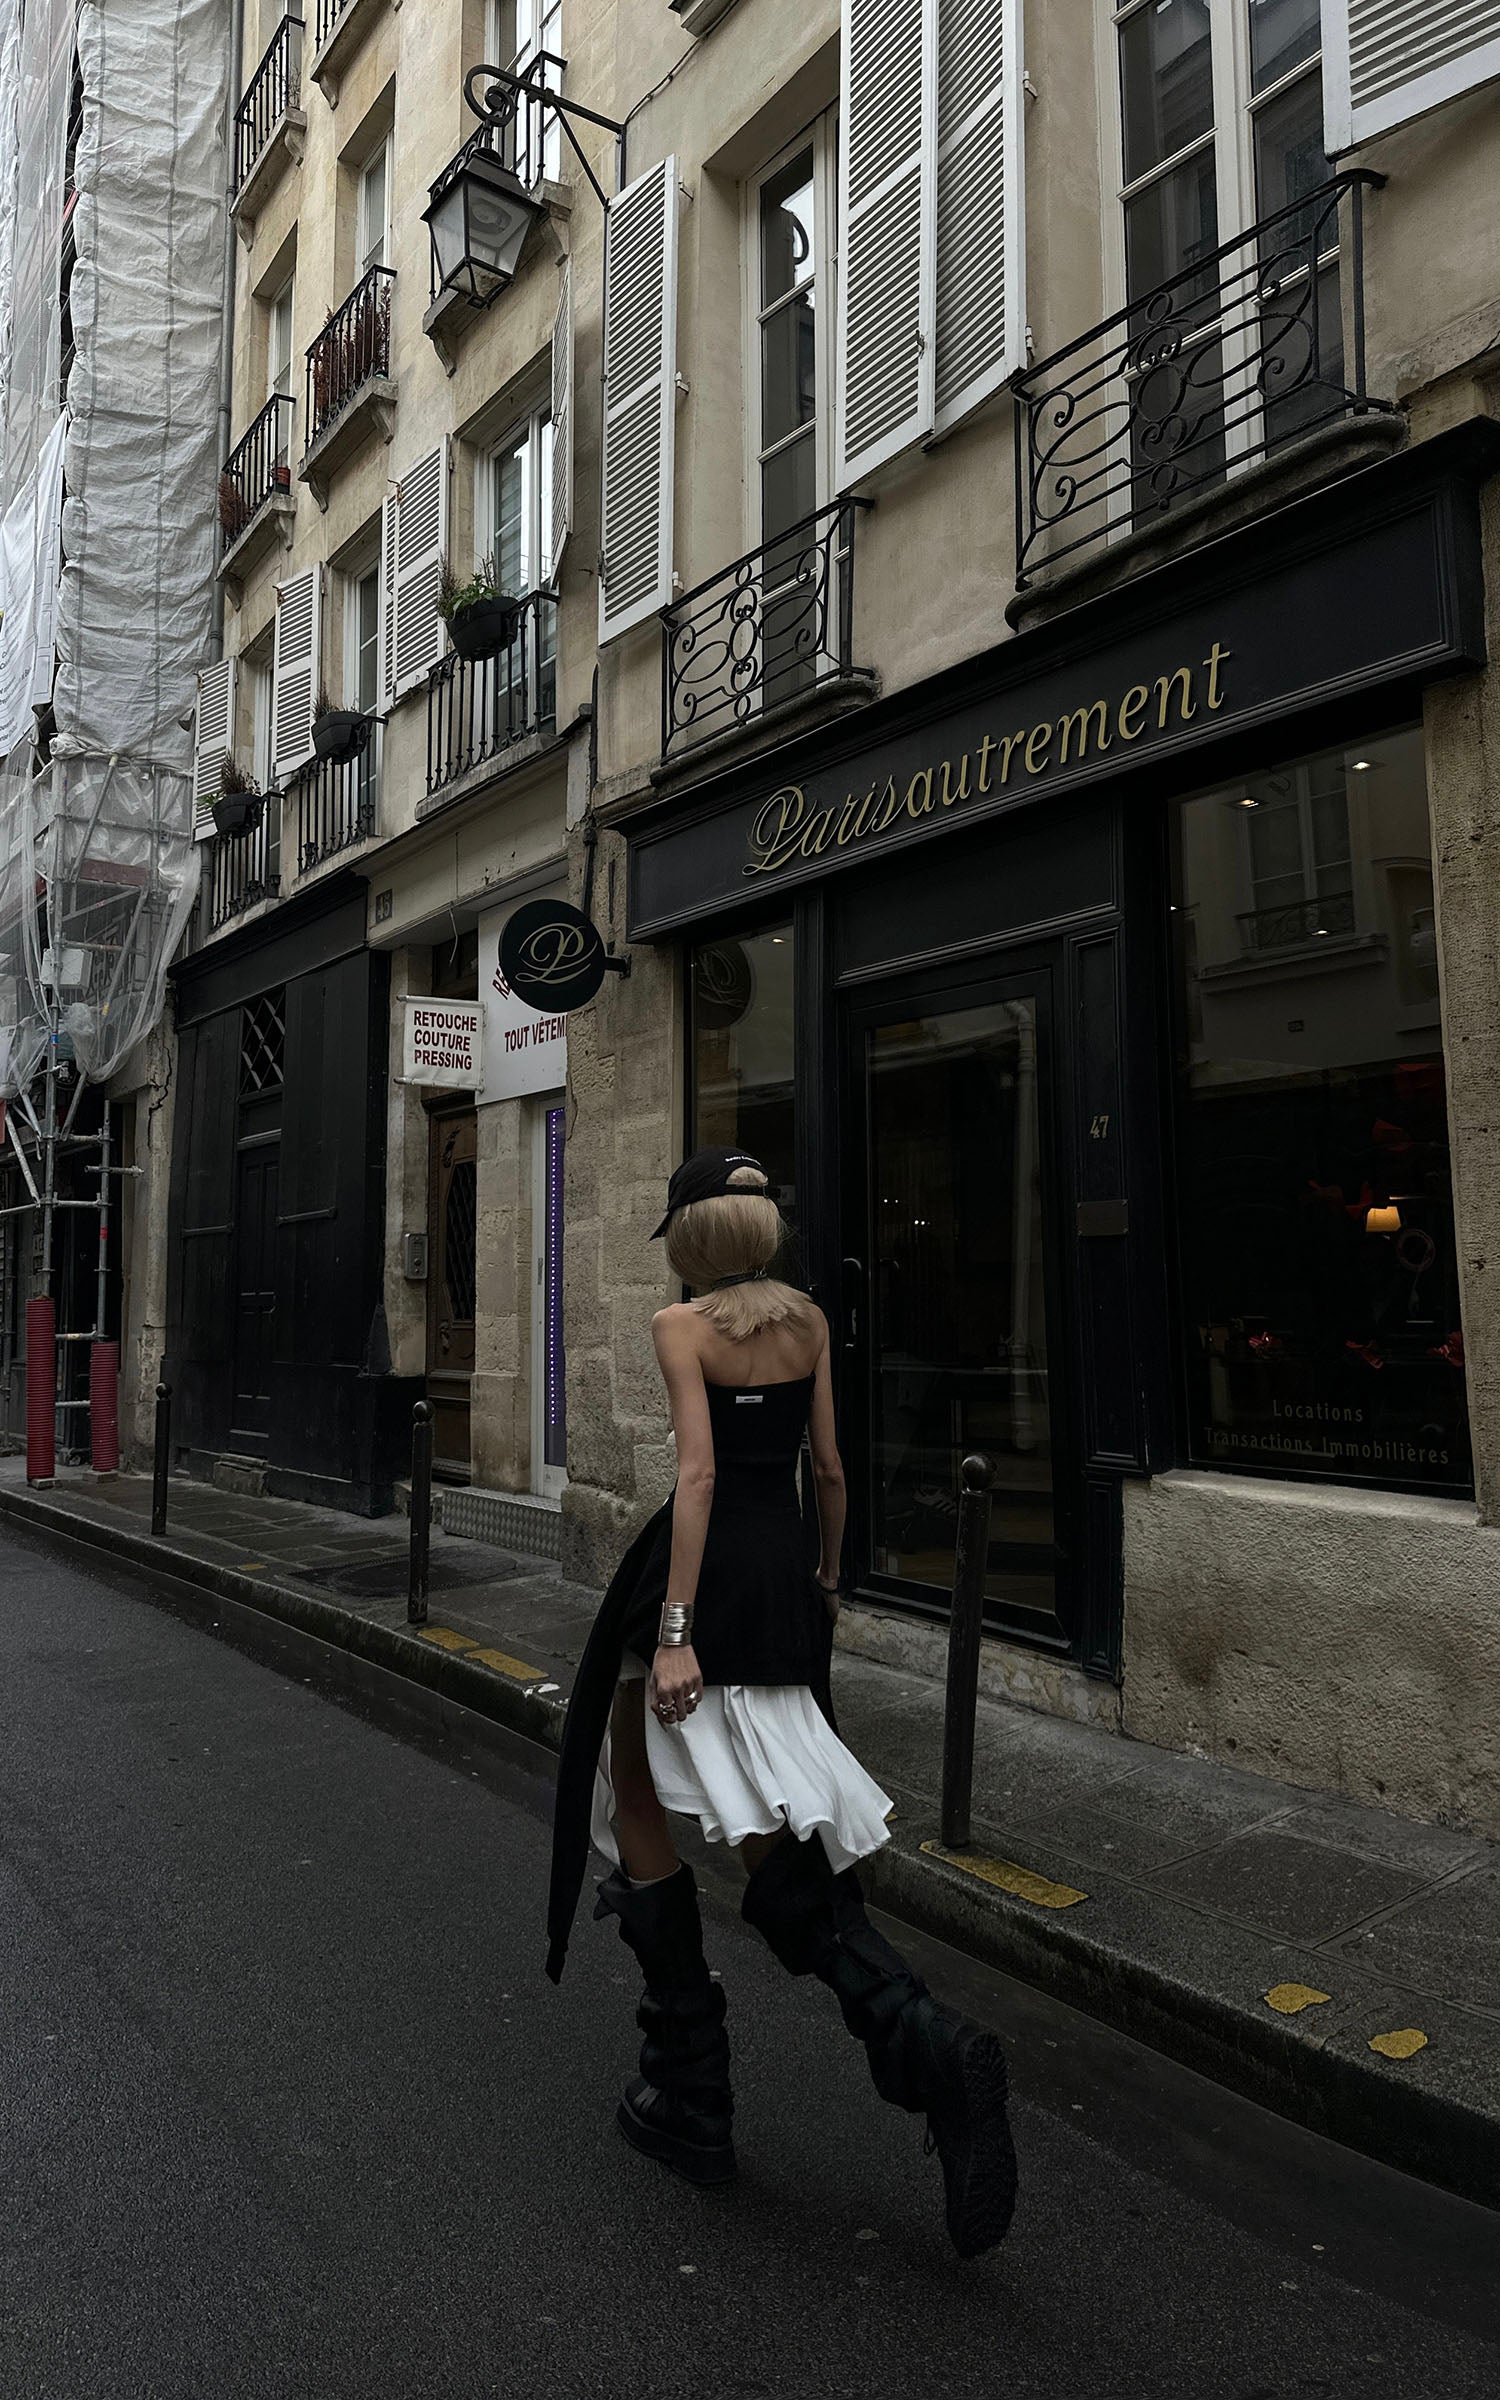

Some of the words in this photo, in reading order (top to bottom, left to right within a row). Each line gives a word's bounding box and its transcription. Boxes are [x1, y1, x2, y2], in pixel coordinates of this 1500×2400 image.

[742, 642, 1232, 876] Parisautrement
[515, 922, 598, 984] P
[413, 1010, 477, 1032] RETOUCHE
[414, 1030, 471, 1052] COUTURE
[504, 1025, 530, 1053] TOUT
[532, 1016, 568, 1045] VÊTEM
[414, 1049, 473, 1071] PRESSING
[1089, 1115, 1110, 1139] 47
[1272, 1399, 1364, 1422] Locations
[1203, 1426, 1313, 1453] Transactions
[1322, 1437, 1449, 1465] Immobilières
